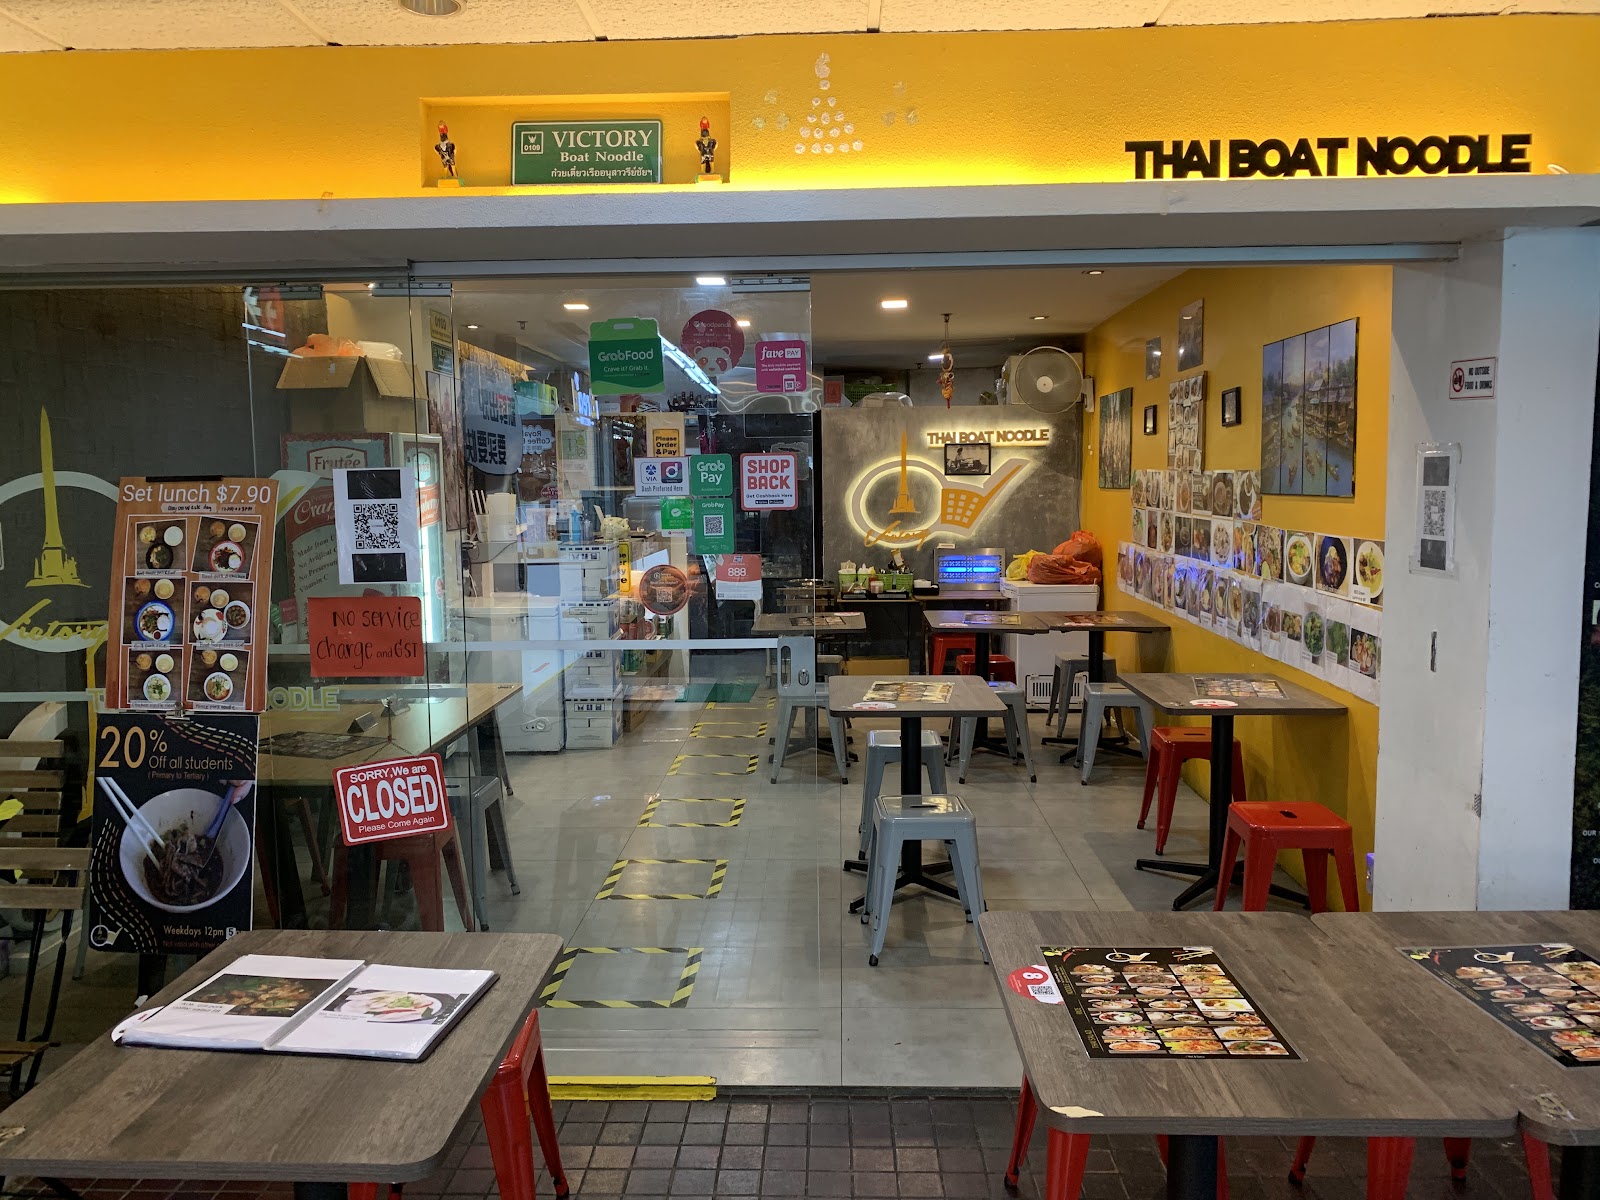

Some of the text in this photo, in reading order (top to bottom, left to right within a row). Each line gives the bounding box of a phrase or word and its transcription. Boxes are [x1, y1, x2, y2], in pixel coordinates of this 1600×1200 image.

[551, 130, 653, 148] VICTORY
[523, 144, 541, 152] 0109
[560, 151, 644, 162] Boat Noodle
[1125, 133, 1533, 180] THAI BOAT NOODLE
[598, 348, 654, 362] GrabFood
[760, 346, 784, 360] fave
[603, 366, 620, 374] Crave
[629, 365, 643, 373] Grab
[927, 428, 1049, 445] THAI BOAT NOODLE
[663, 449, 677, 457] Pay
[697, 460, 725, 472] Grab
[747, 460, 790, 474] SHOP
[700, 472, 722, 485] Pay
[748, 475, 790, 490] BACK
[122, 484, 271, 504] Set lunch $7.90
[728, 567, 746, 577] 888
[361, 607, 421, 631] service
[376, 647, 393, 658] and
[394, 638, 418, 658] GST
[99, 726, 168, 769] 20%
[149, 755, 233, 771] Off all students
[412, 765, 427, 773] are
[346, 774, 439, 824] CLOSED
[358, 815, 435, 833] Please Come Again
[1582, 829, 1597, 837] OUR
[163, 925, 234, 938] Weekdays 12pm 5
